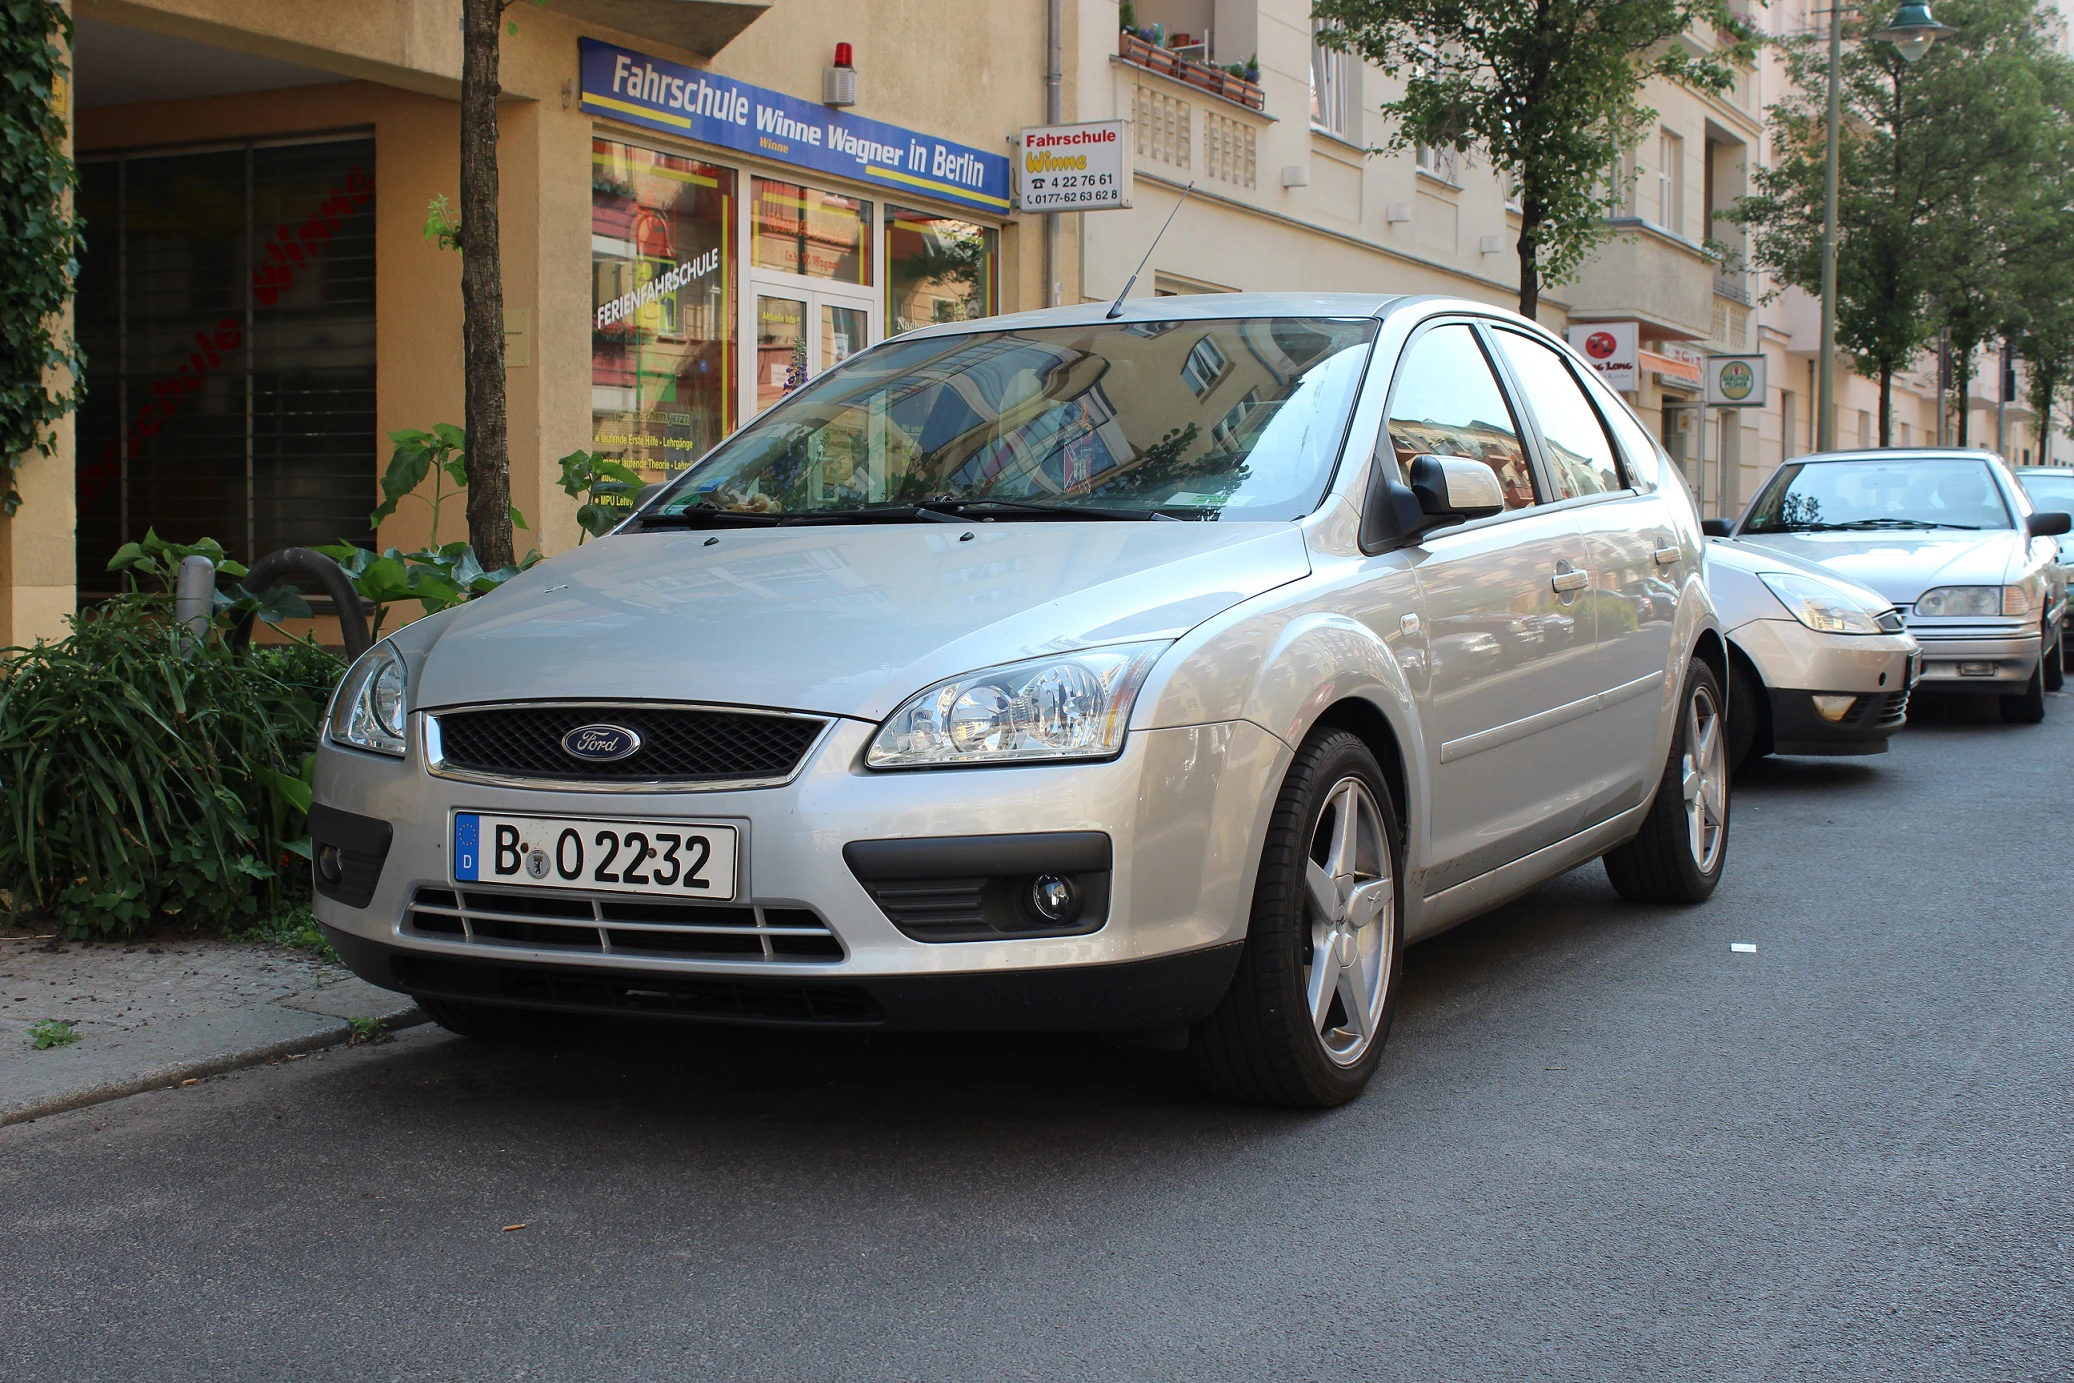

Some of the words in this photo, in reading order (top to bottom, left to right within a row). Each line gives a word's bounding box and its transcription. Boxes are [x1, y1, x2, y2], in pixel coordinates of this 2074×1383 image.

[612, 54, 749, 126] Fahrschule
[756, 104, 822, 147] Winne
[828, 124, 904, 167] Wagner
[908, 138, 926, 173] in
[932, 144, 984, 188] Berlin
[759, 136, 789, 154] Winne
[1026, 129, 1116, 148] Fahrschule
[1025, 150, 1087, 173] Winne
[1051, 177, 1059, 188] 4
[1062, 176, 1077, 188] 22
[1081, 175, 1096, 186] 76
[1099, 173, 1113, 185] 61
[1035, 192, 1077, 204] 0177-62
[1079, 191, 1093, 201] 63
[1095, 190, 1109, 200] 62
[1111, 189, 1118, 200] 8
[597, 247, 719, 330] FERIENFAHRSCHULE
[601, 433, 627, 445] laufende
[628, 434, 644, 446] Erste
[645, 435, 659, 446] Hilfe
[663, 436, 693, 450] Lehrgänge
[648, 458, 670, 470] Theorie
[600, 494, 615, 506] MPU
[576, 730, 620, 752] Ford
[463, 854, 472, 869] D
[495, 824, 522, 876] B
[594, 830, 711, 889] 2232
